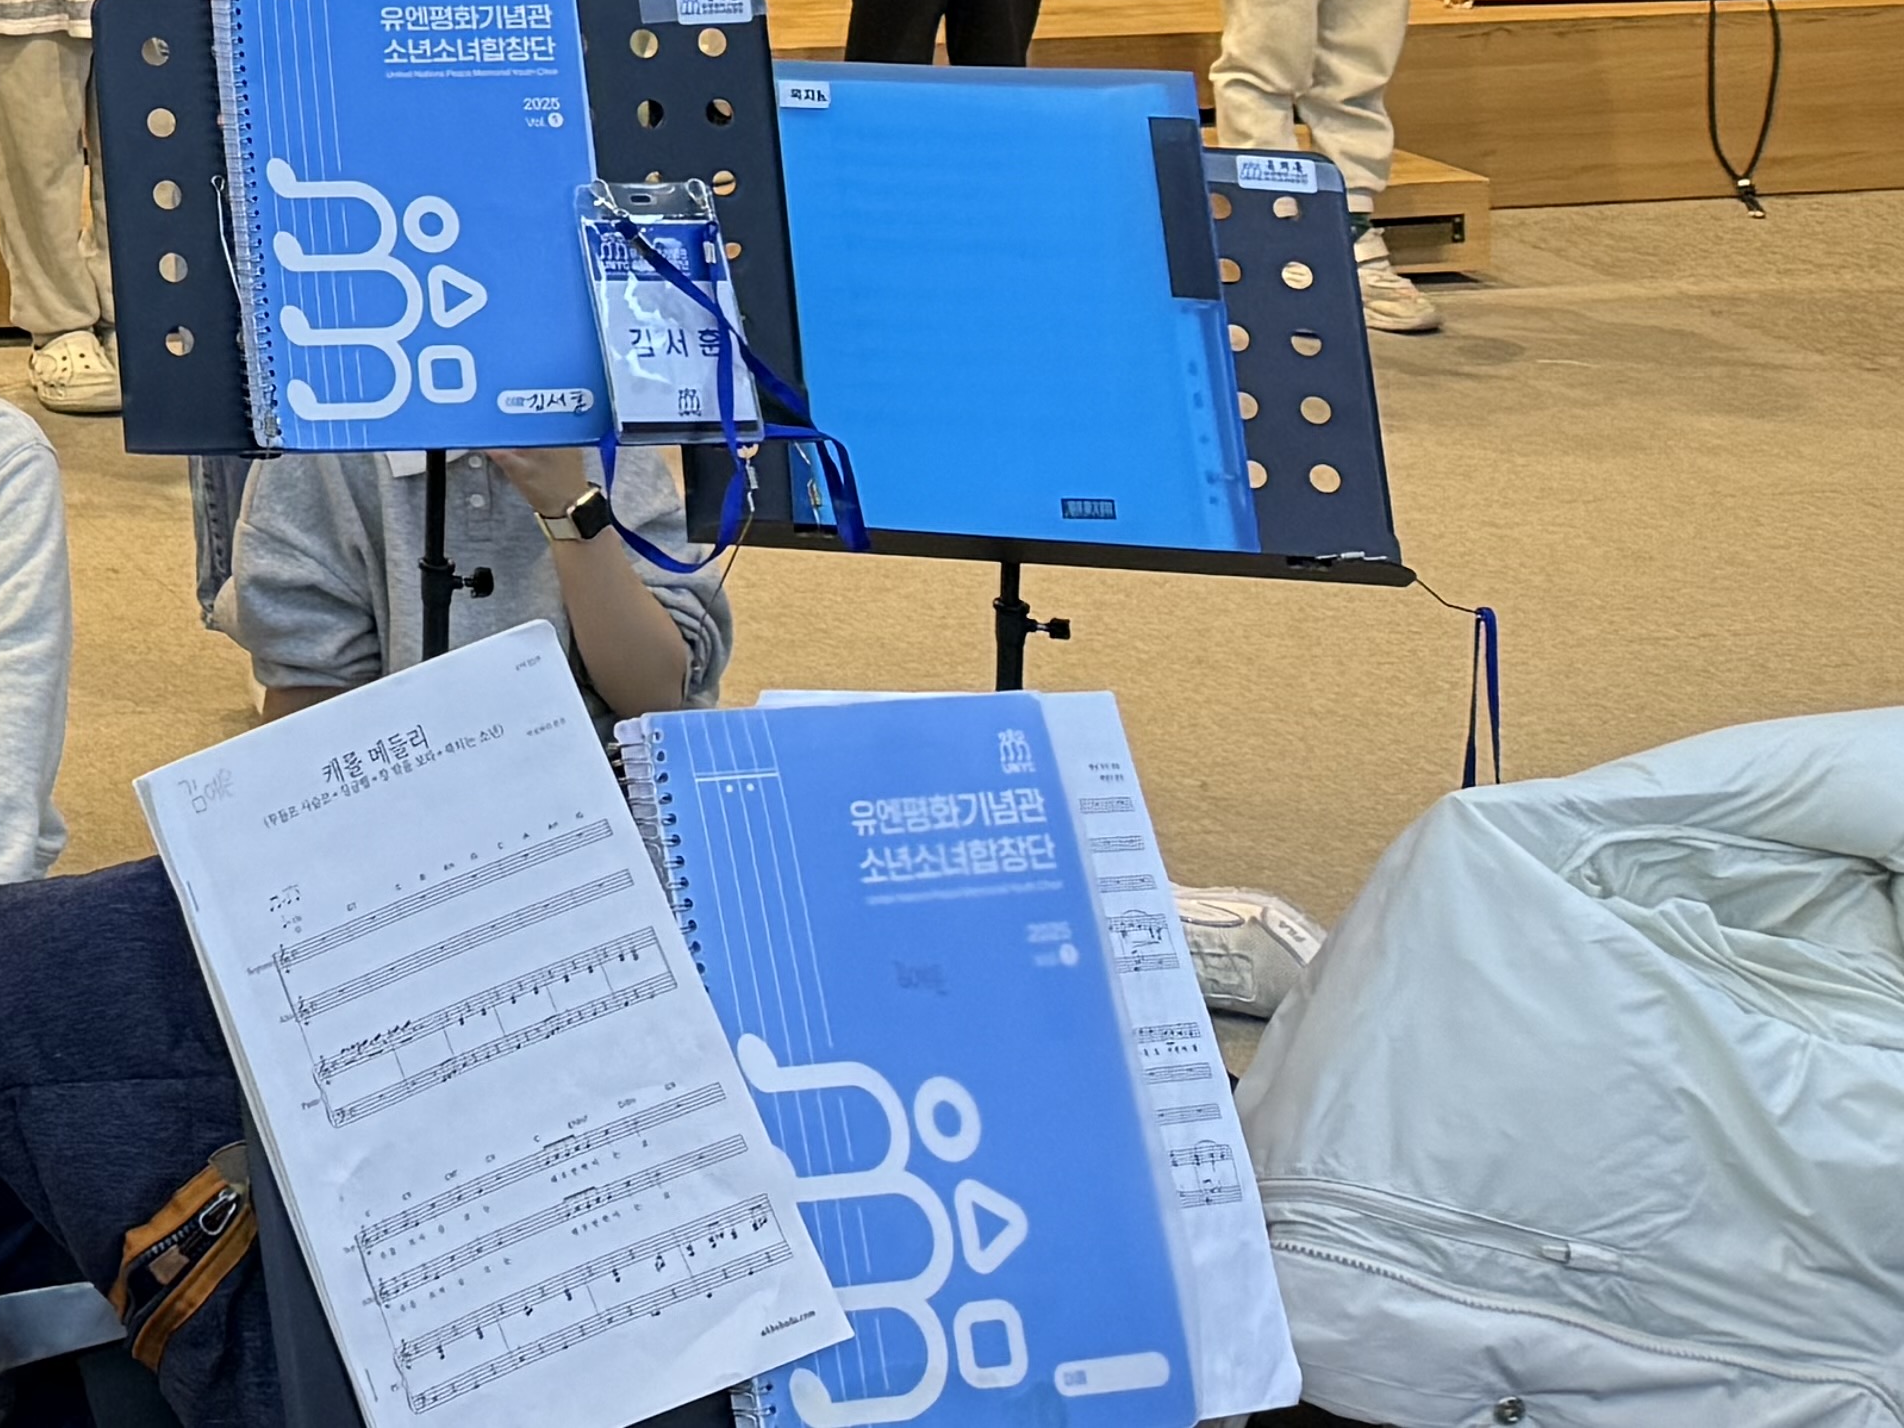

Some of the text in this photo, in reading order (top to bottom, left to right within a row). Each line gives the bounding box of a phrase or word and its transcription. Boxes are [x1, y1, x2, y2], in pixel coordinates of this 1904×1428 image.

[379, 3, 553, 32] 유엔평화기념관
[383, 35, 557, 64] 소년소녀합창단
[368, 724, 429, 766] 메들리
[849, 787, 1048, 836] 유엔평화기념관
[859, 833, 1058, 884] 소년소녀합창단
